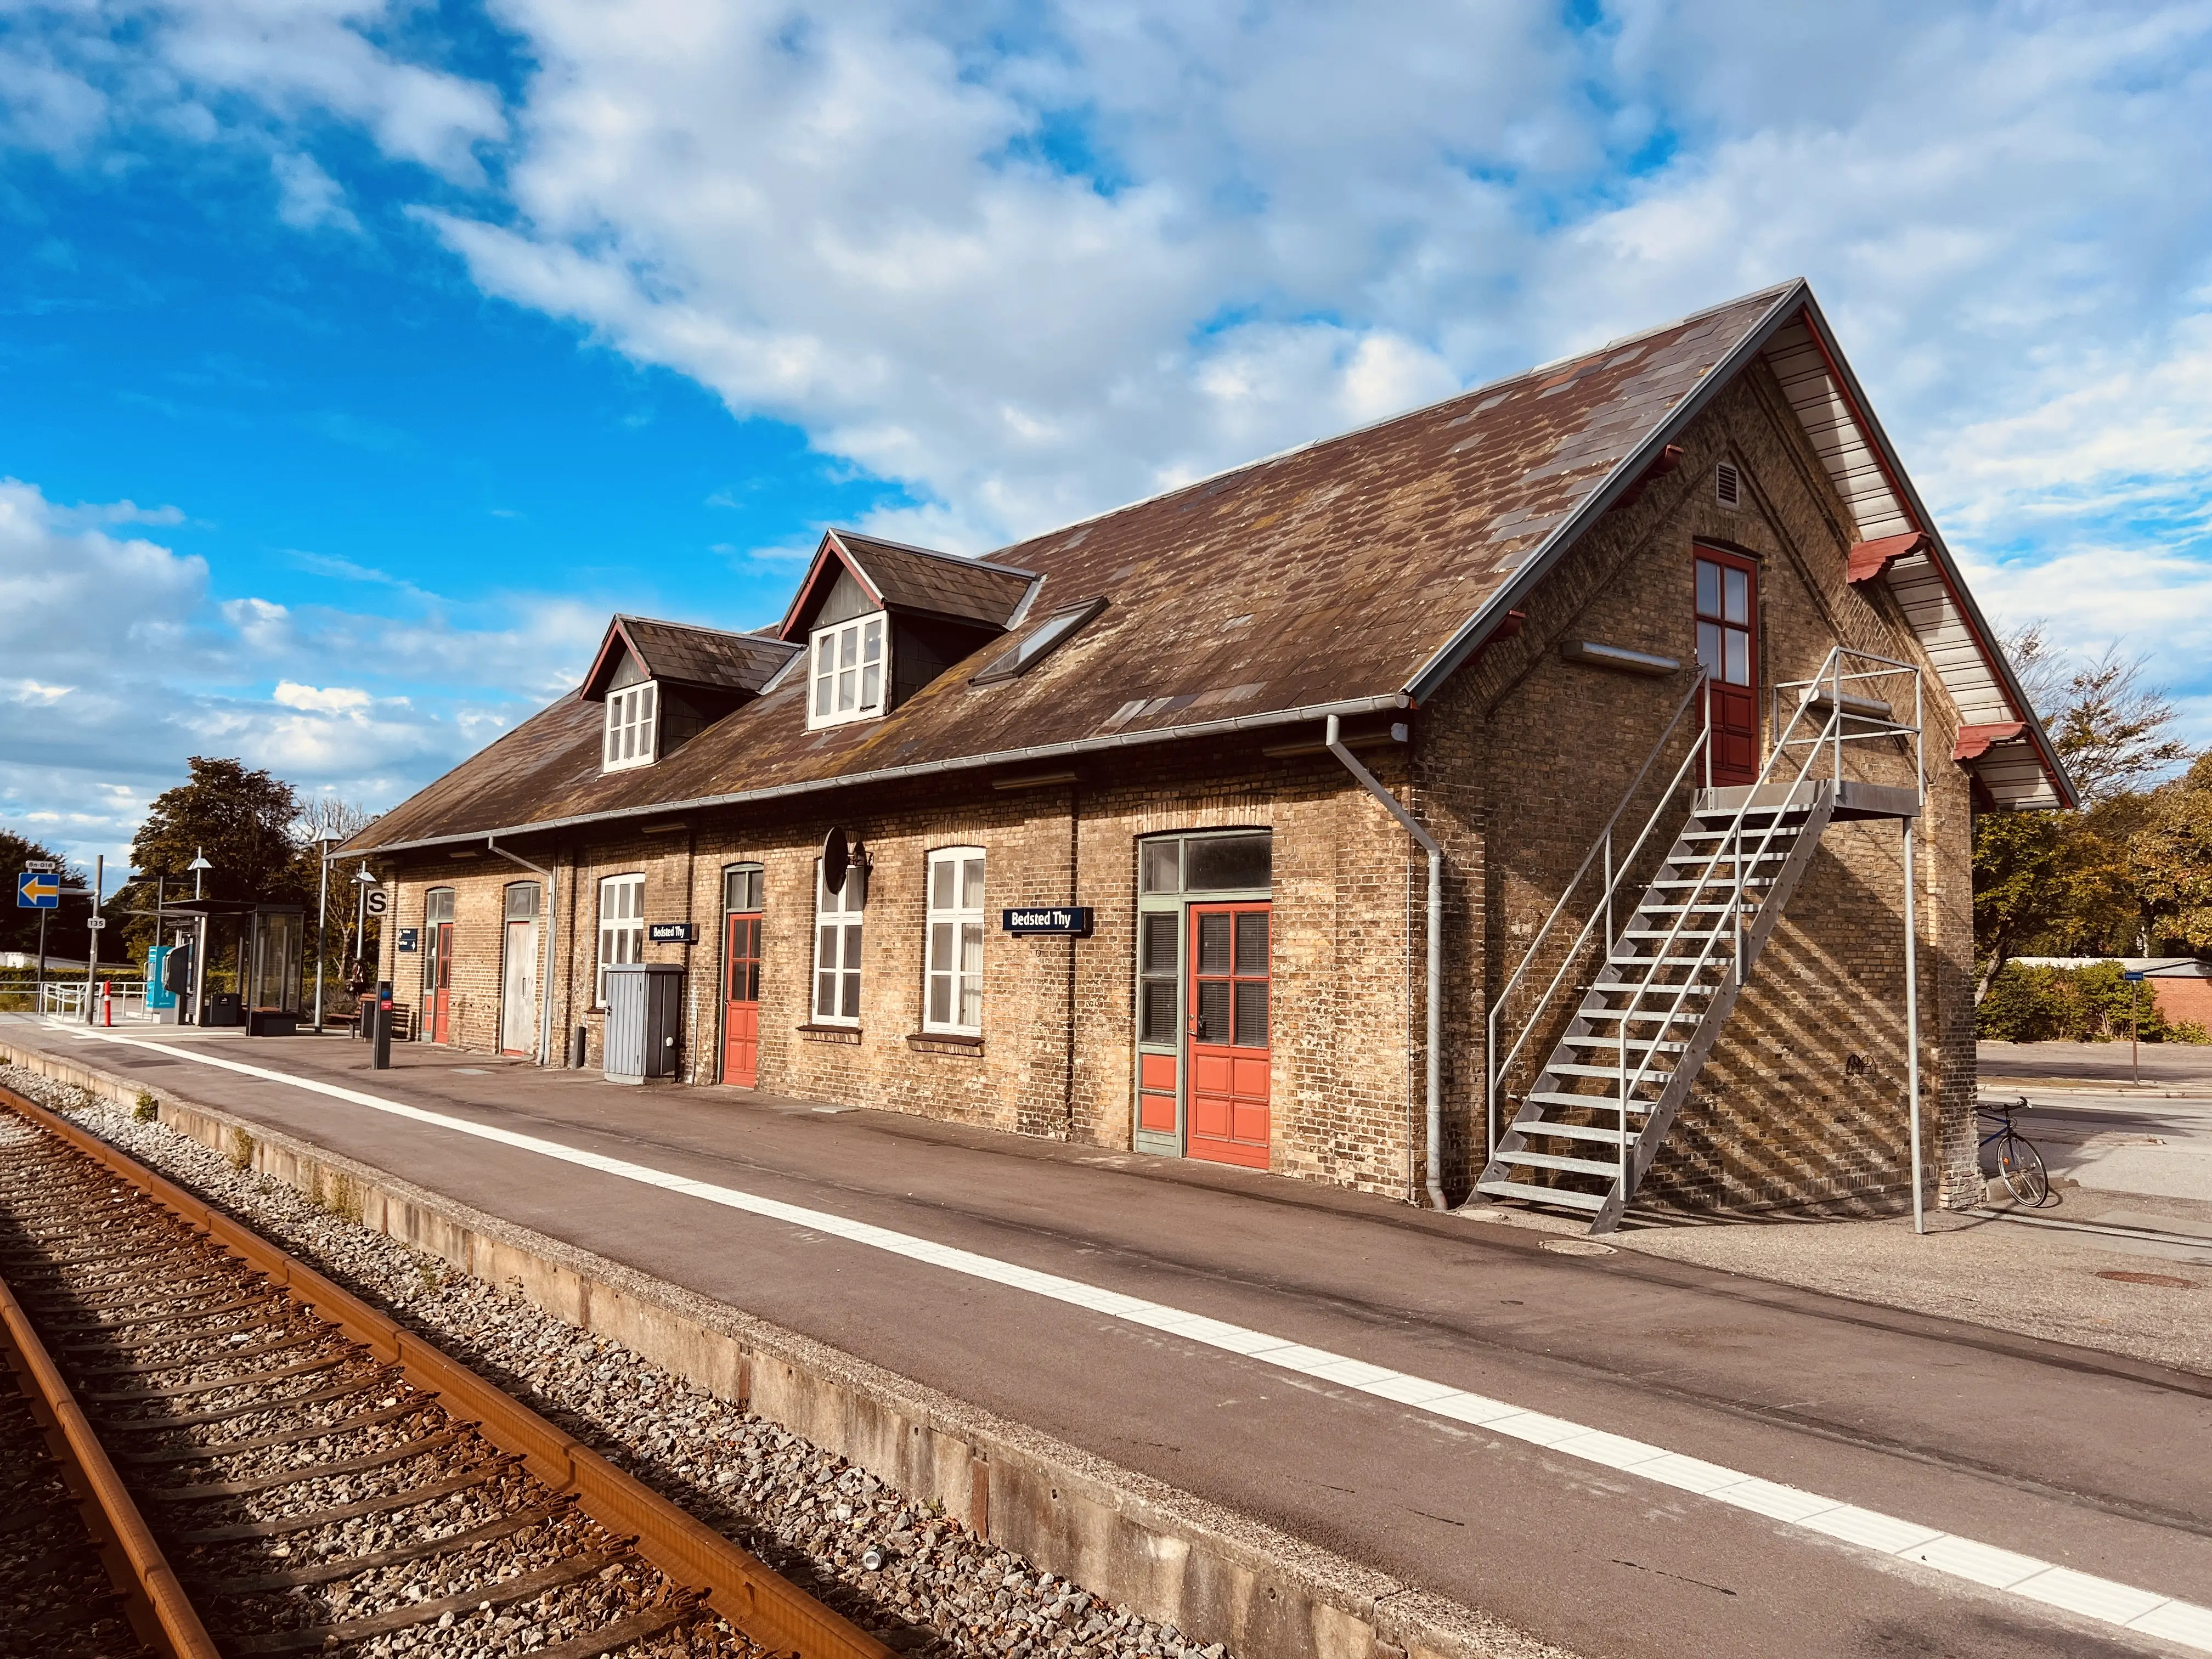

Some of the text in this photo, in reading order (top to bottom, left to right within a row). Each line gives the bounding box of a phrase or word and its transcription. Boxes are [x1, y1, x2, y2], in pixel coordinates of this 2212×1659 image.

[369, 892, 386, 912] S
[1012, 911, 1071, 928] Bedsted Thy
[653, 926, 685, 938] Bedsted Thy
